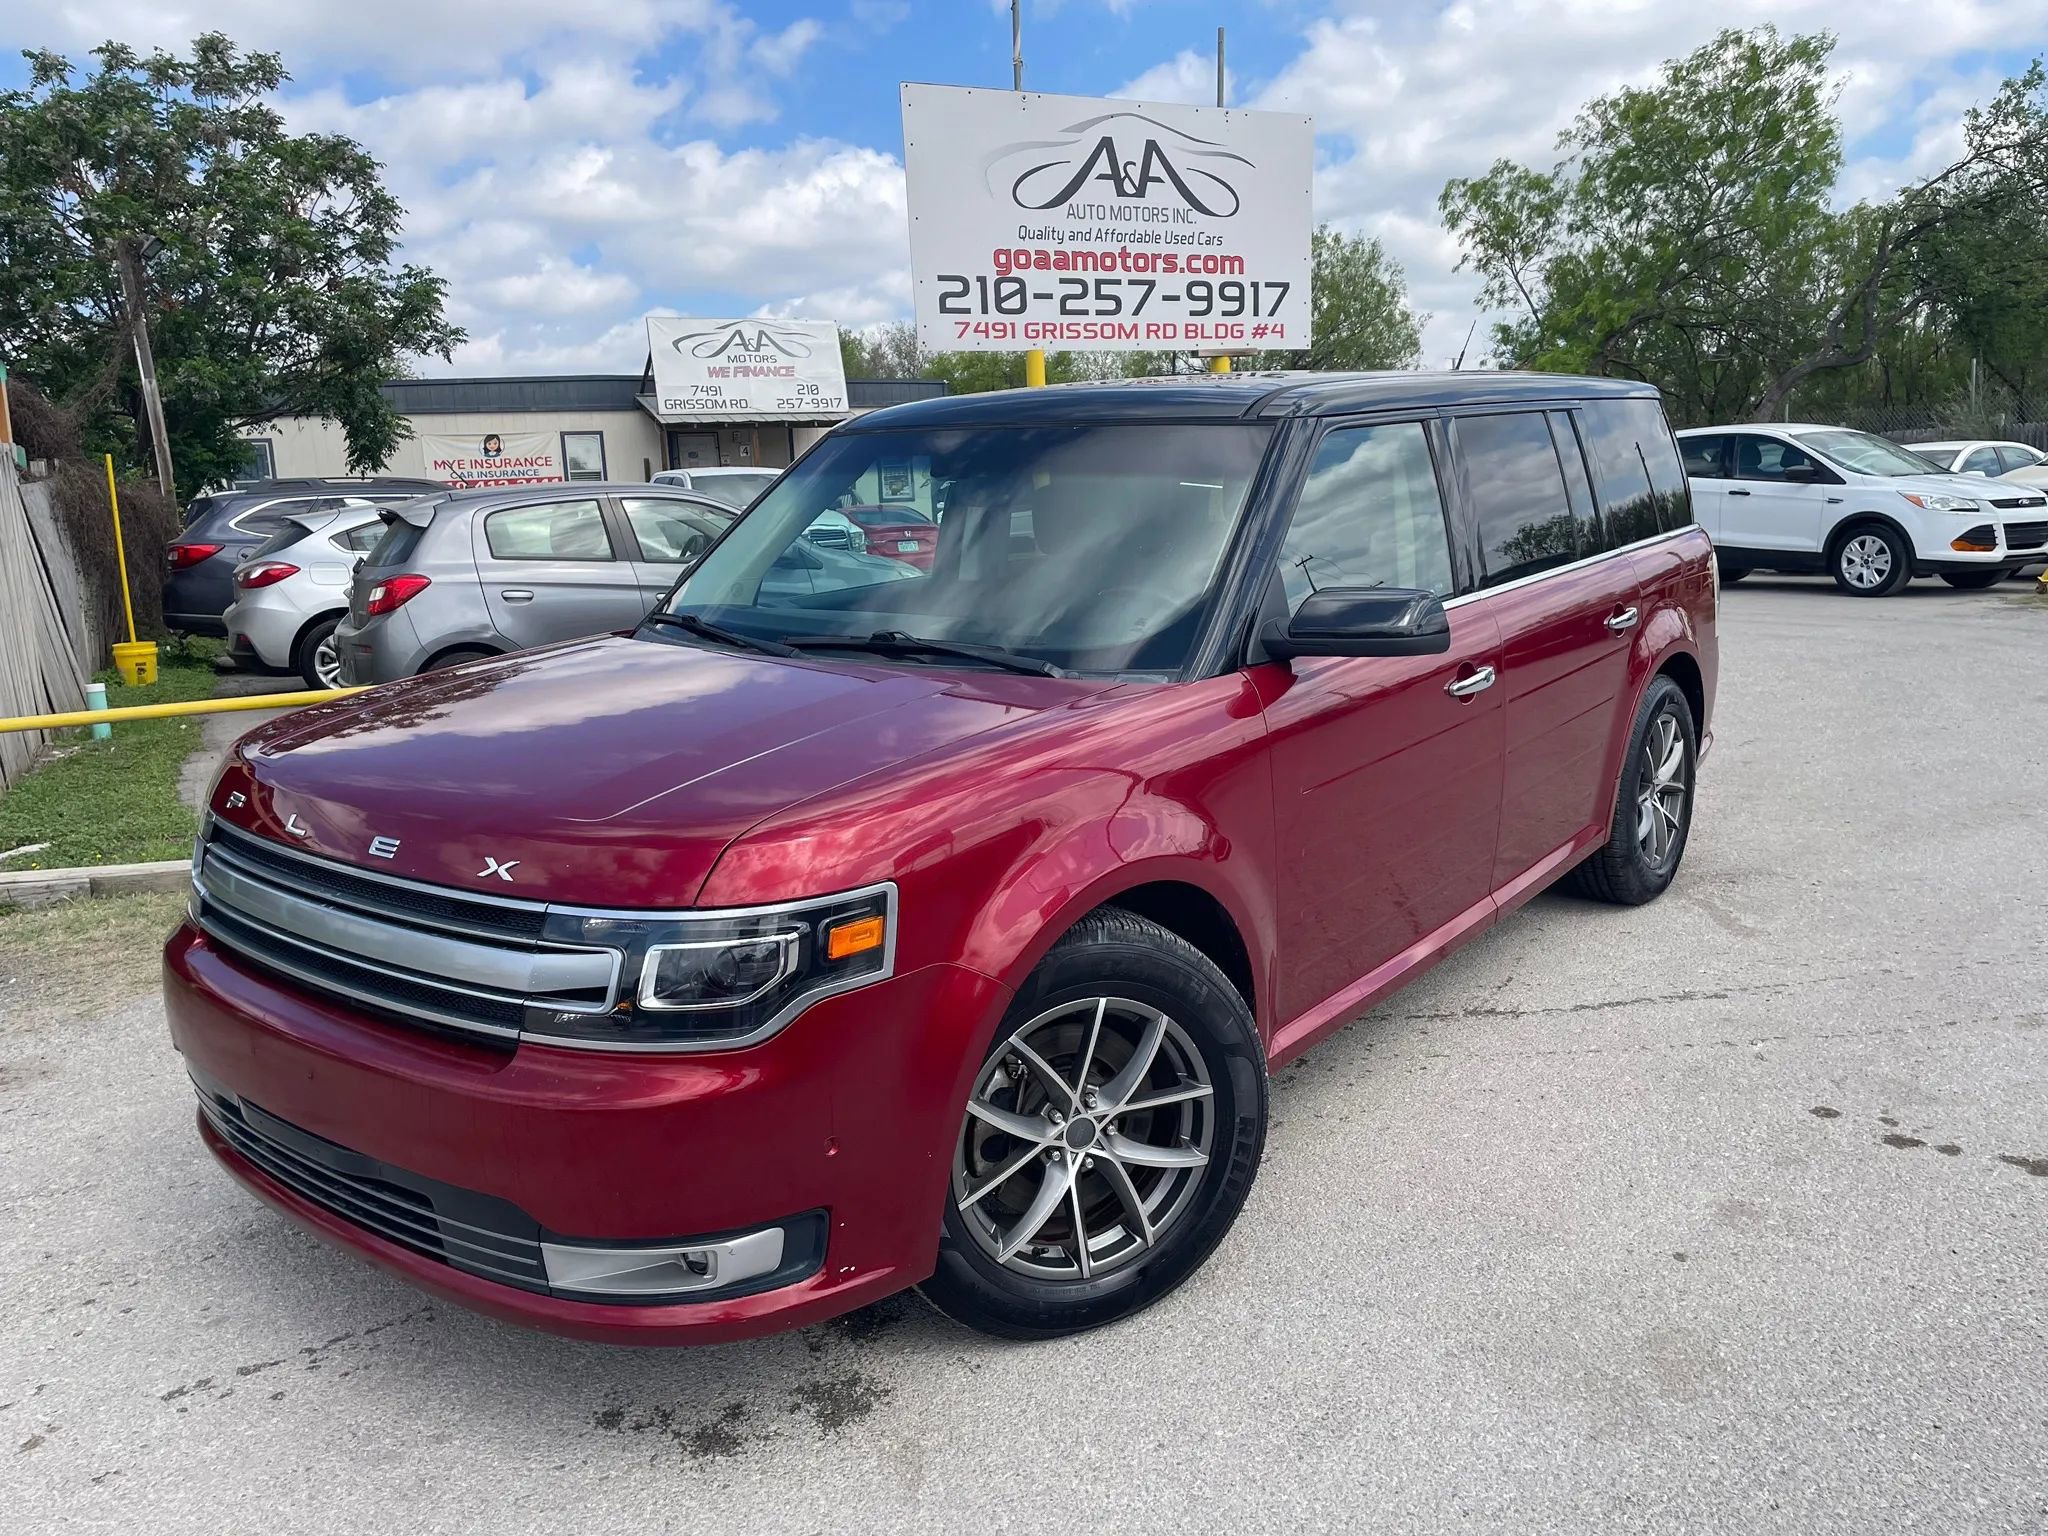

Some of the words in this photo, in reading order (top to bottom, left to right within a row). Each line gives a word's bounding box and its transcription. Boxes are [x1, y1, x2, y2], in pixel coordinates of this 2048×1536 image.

[1036, 136, 1214, 212] A&A
[1066, 204, 1107, 221] AUTO
[1109, 205, 1169, 223] MOTORS
[1172, 207, 1198, 225] INC.
[1018, 224, 1065, 244] Quality
[1068, 227, 1092, 242] and
[1094, 227, 1162, 245] Affordable
[1164, 229, 1194, 246] Used
[1197, 231, 1223, 247] Cars
[993, 246, 1245, 276] goaamotors.com
[937, 274, 1291, 317] 210-257-9917
[954, 321, 1016, 340] 7491
[1023, 322, 1139, 340] GRISSOM
[1145, 323, 1177, 340] RD
[1184, 323, 1245, 340] BLDG
[1251, 324, 1286, 340] #4
[706, 330, 799, 357] A&A
[727, 354, 778, 364] MOTORS
[707, 365, 731, 378] WE
[733, 365, 795, 378] FINANCE
[690, 385, 723, 397] 7491
[796, 384, 820, 396] 210
[664, 398, 728, 410] GRISSOM
[776, 397, 842, 410] 257-9917
[470, 456, 553, 470] INSURANCE
[449, 469, 474, 480] CAR
[477, 468, 540, 479] INSURANCE
[226, 790, 520, 882] FLEX
